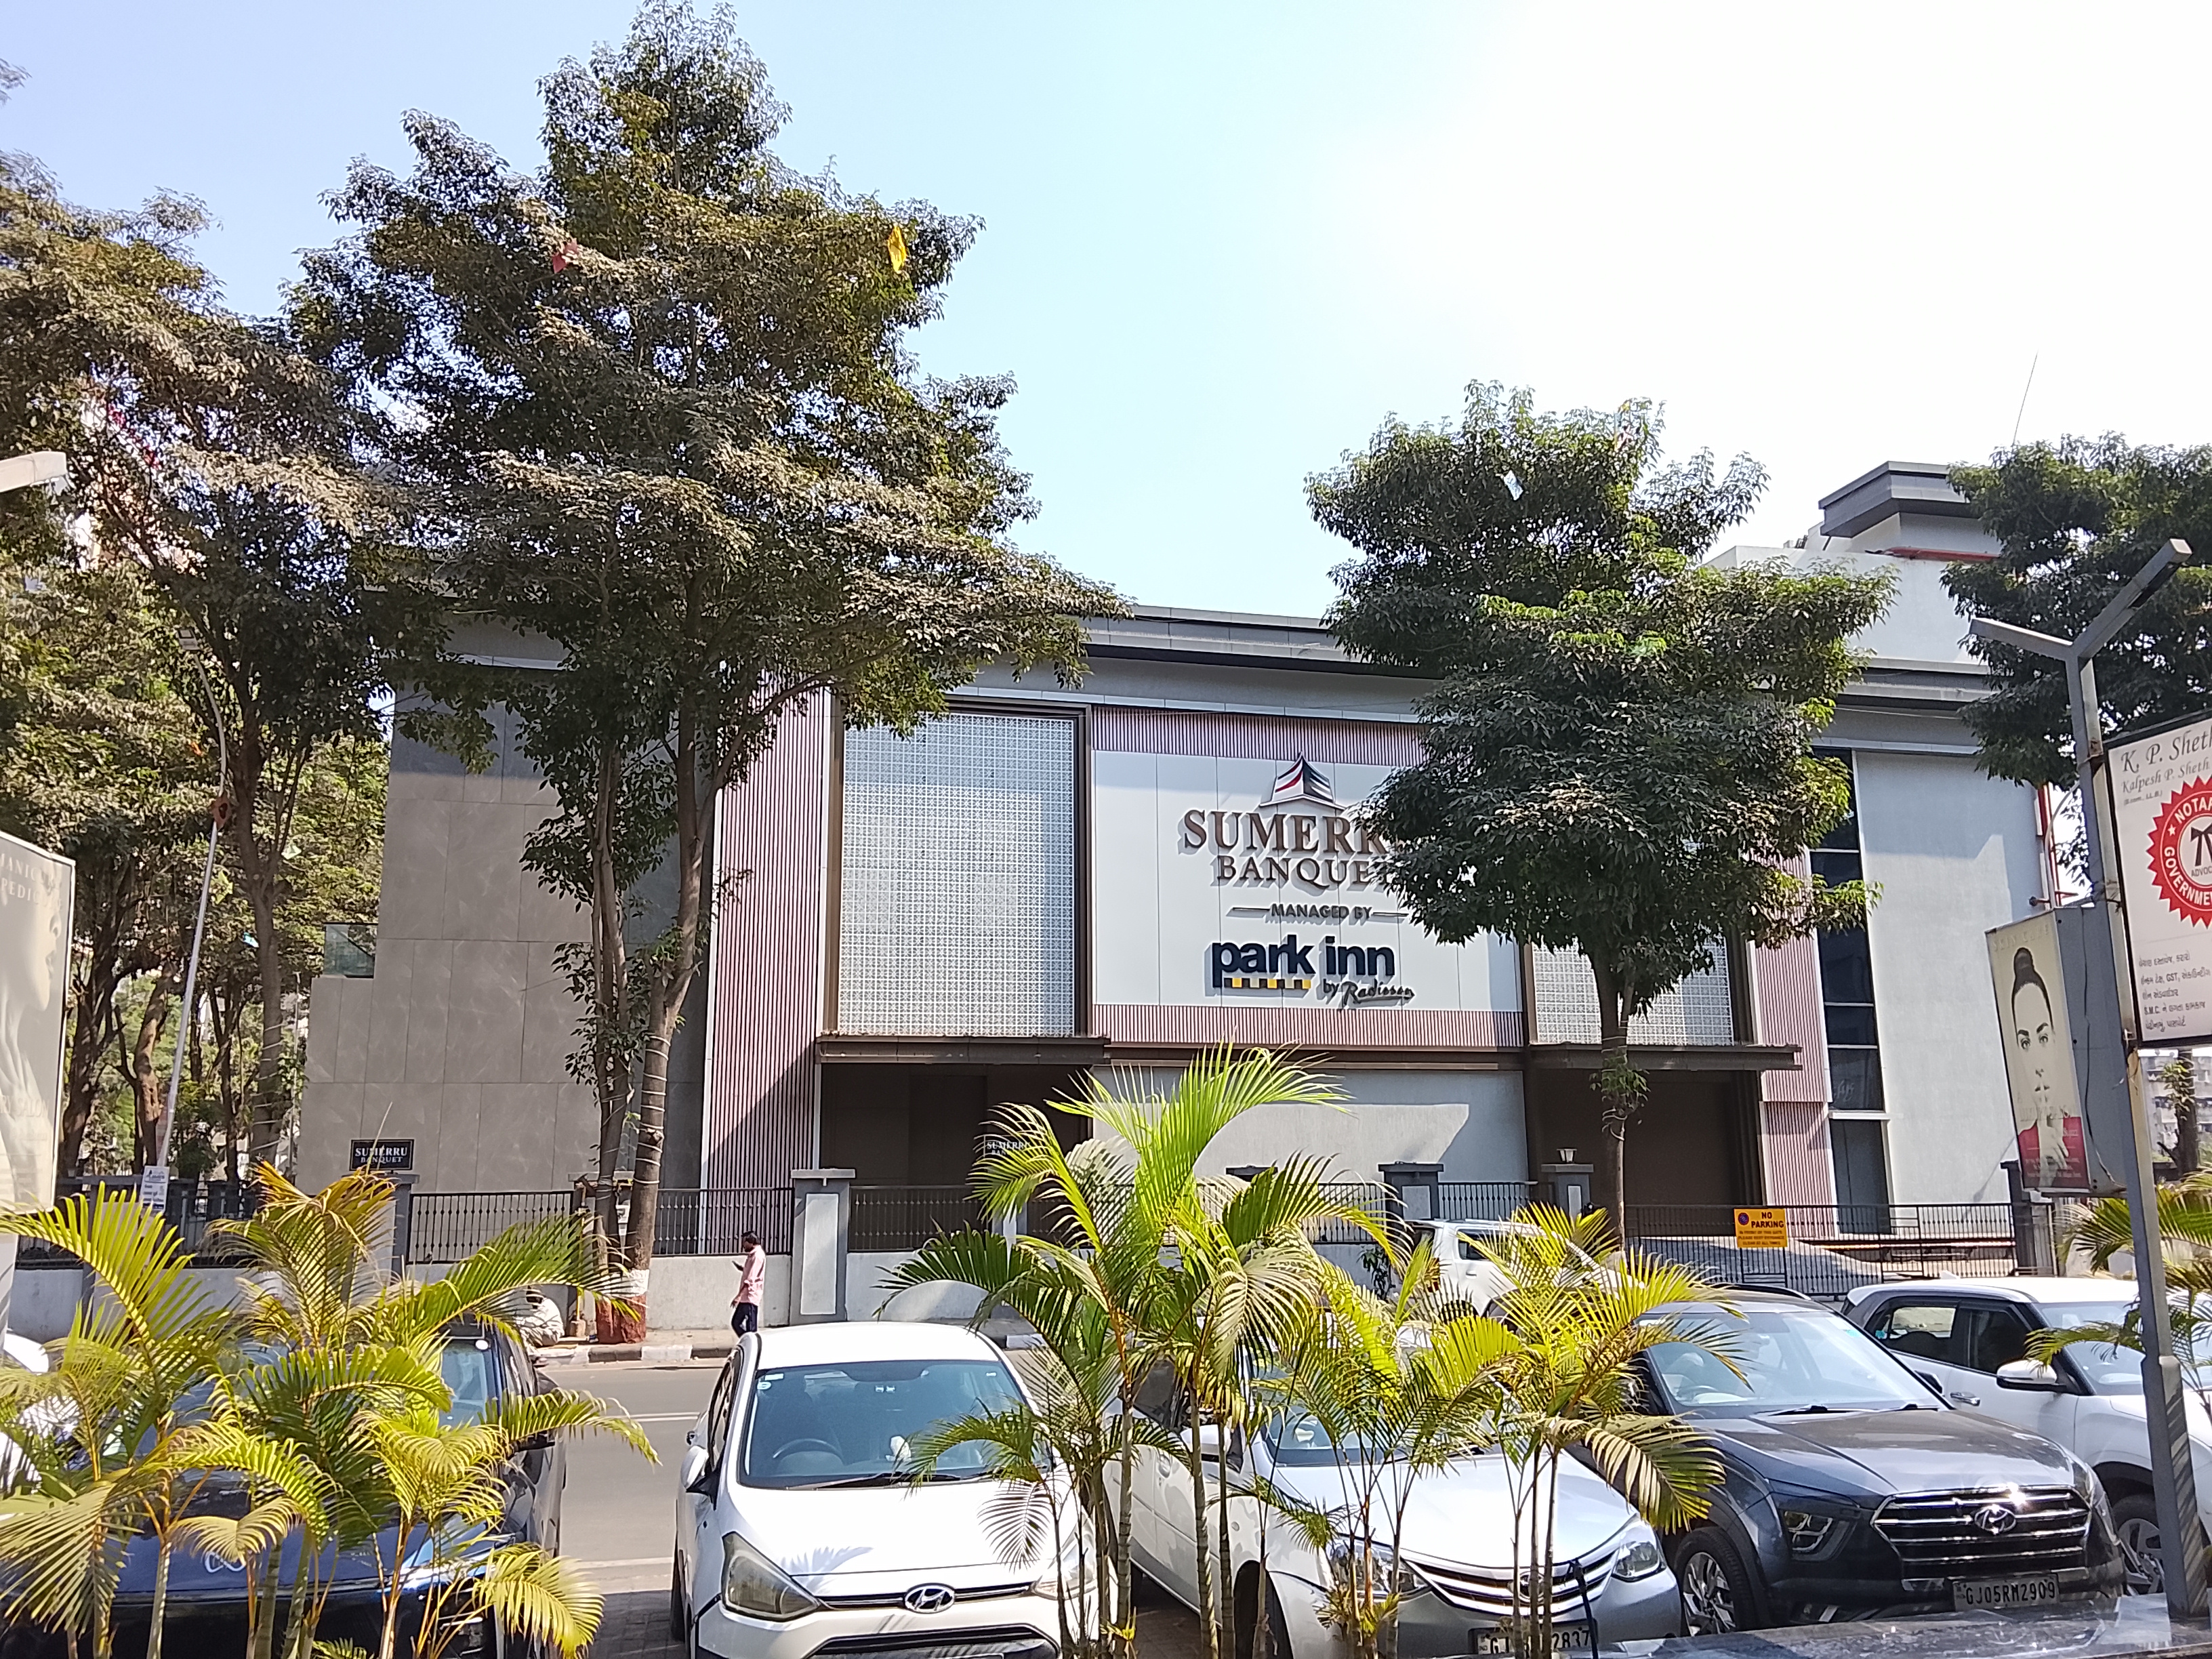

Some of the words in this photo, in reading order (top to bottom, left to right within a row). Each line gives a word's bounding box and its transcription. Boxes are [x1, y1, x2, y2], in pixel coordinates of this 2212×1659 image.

[2121, 750, 2139, 773] K.
[2146, 743, 2163, 764] P.
[2169, 724, 2212, 760] Shet
[2122, 769, 2161, 793] Kalpesh
[1184, 809, 1393, 854] SUMERR
[2164, 846, 2212, 906] GOVERNME
[1271, 903, 1349, 919] MANAGED
[1212, 934, 1316, 988] park
[1326, 935, 1395, 977] inn
[1324, 979, 1340, 998] by
[1341, 978, 1415, 1006] Radisson
[1966, 1581, 2055, 1605] GJ05RM2909
